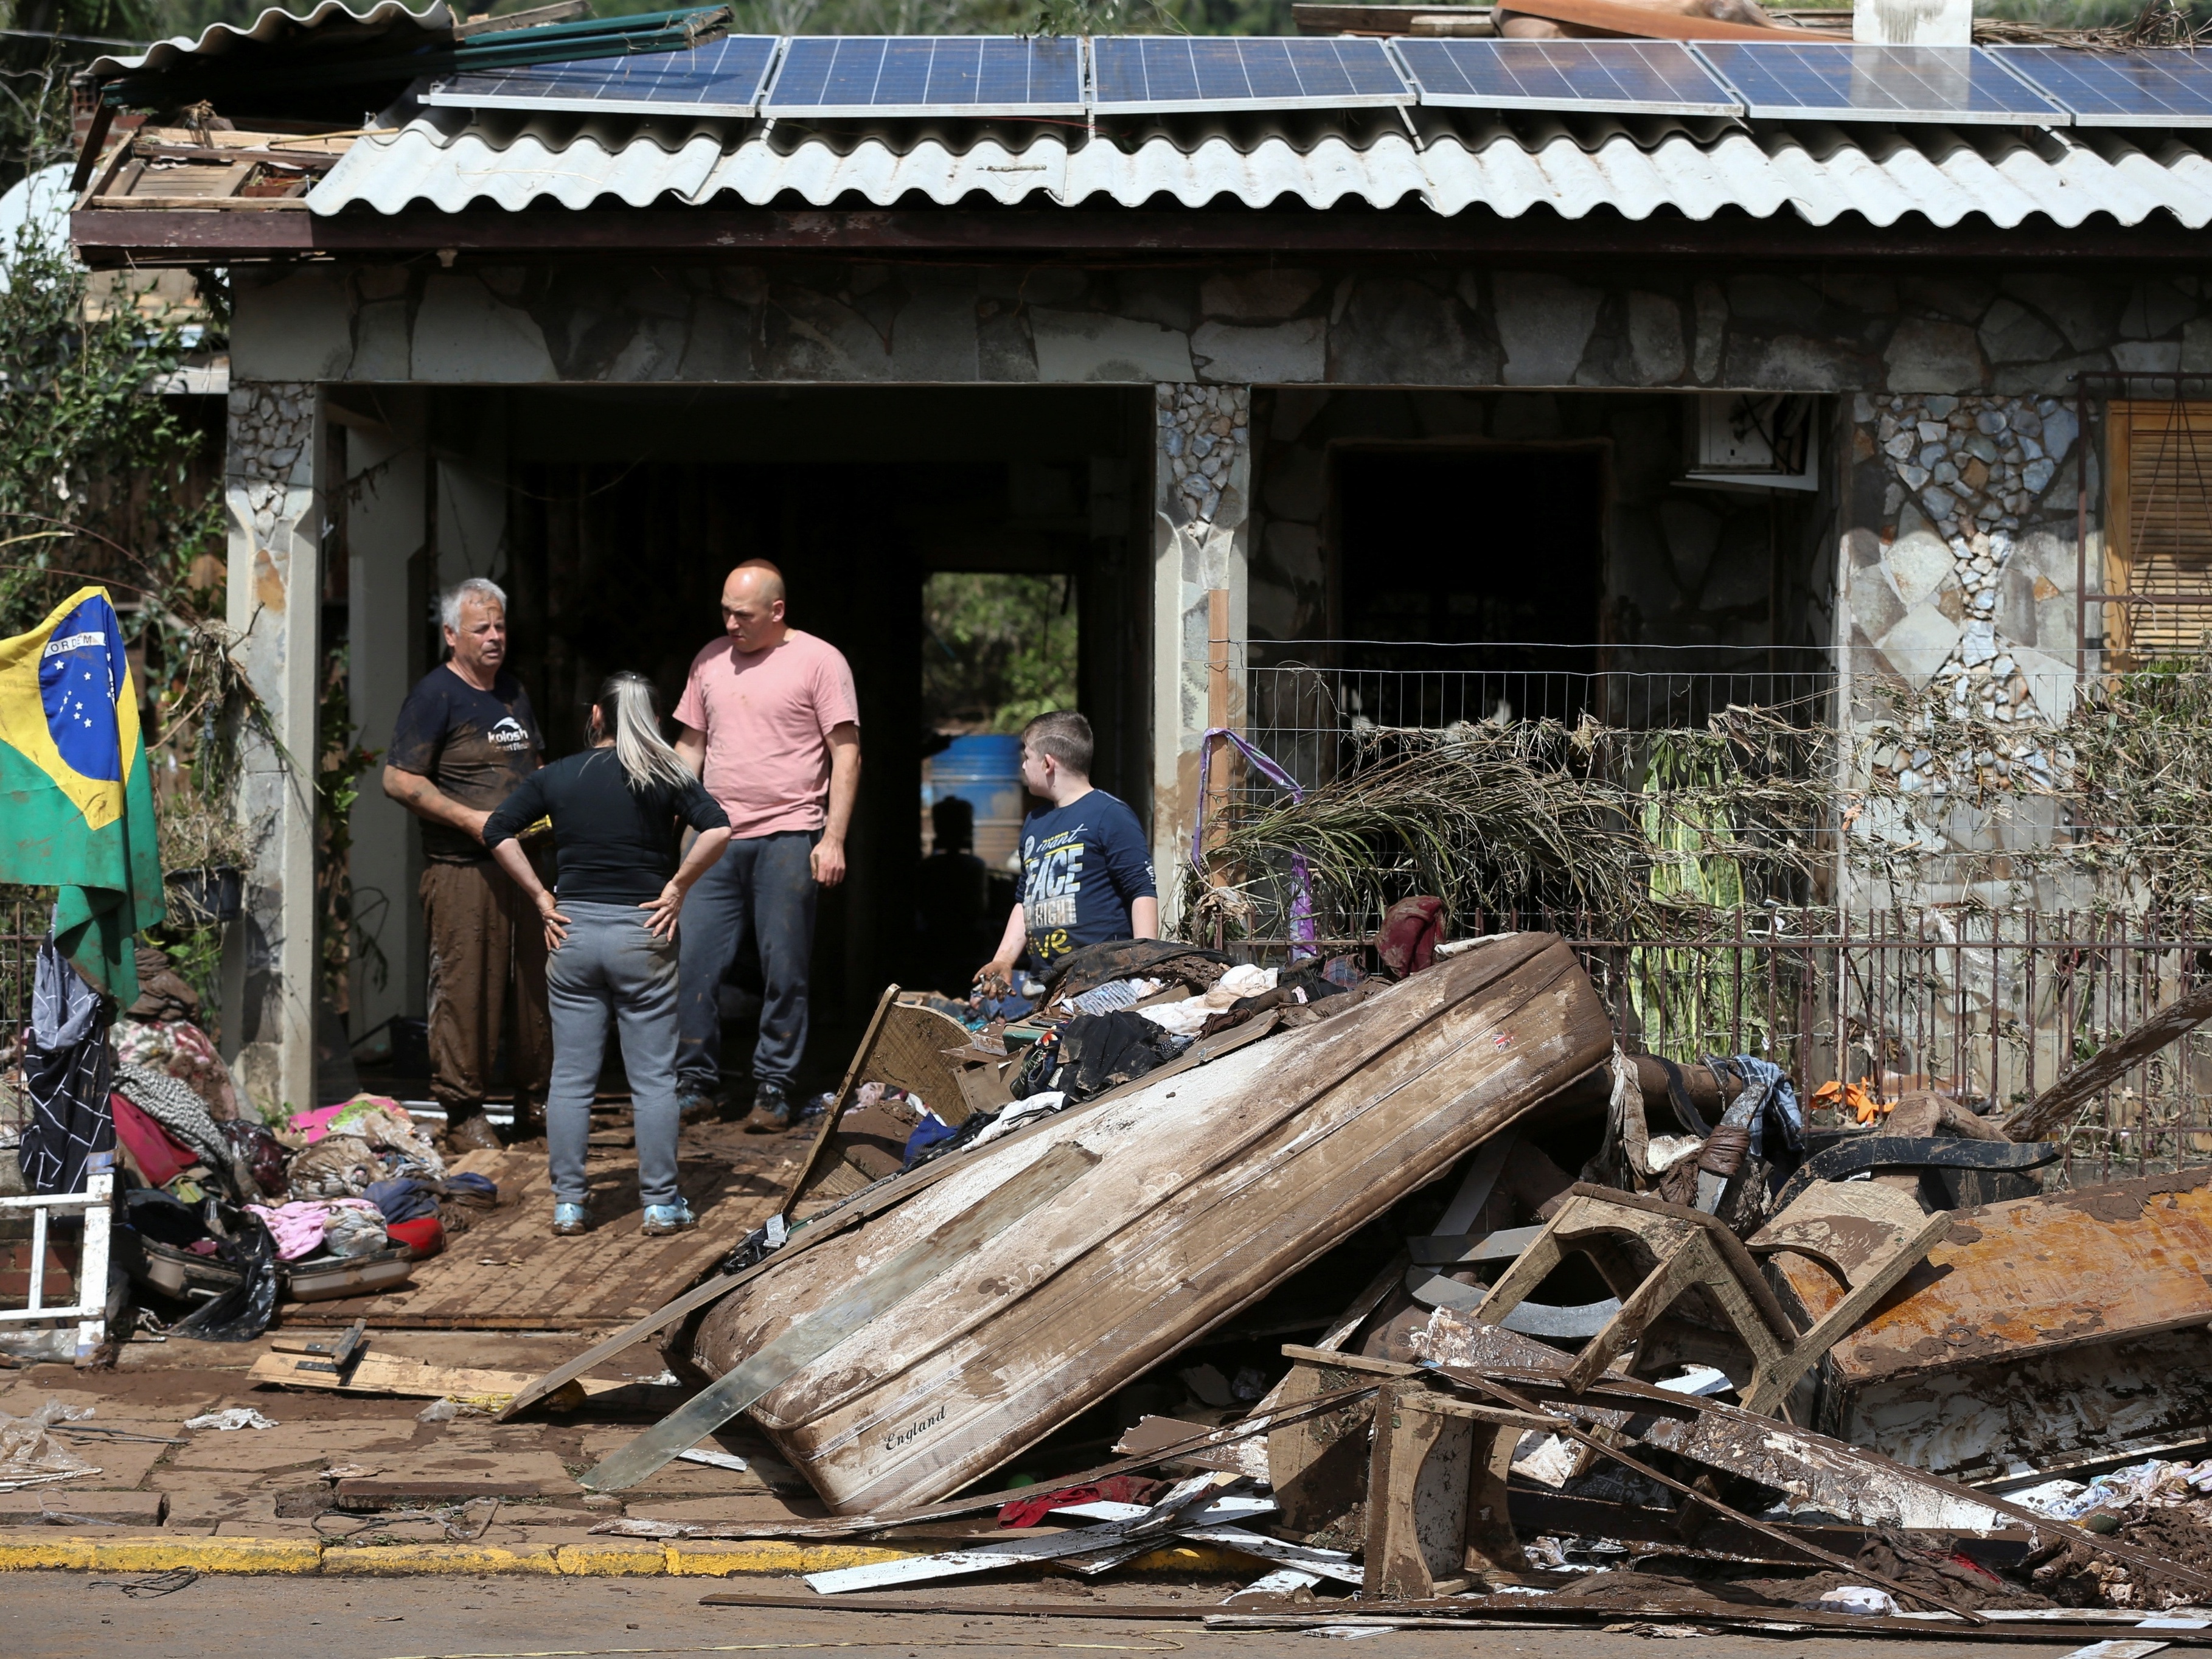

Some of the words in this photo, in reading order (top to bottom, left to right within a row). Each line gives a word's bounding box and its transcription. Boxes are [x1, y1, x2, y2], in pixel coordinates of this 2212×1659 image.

[50, 635, 91, 652] ORDEM
[487, 728, 529, 743] kolosh
[1036, 823, 1088, 853] want
[1024, 846, 1084, 905] EACE
[884, 1405, 947, 1451] England
